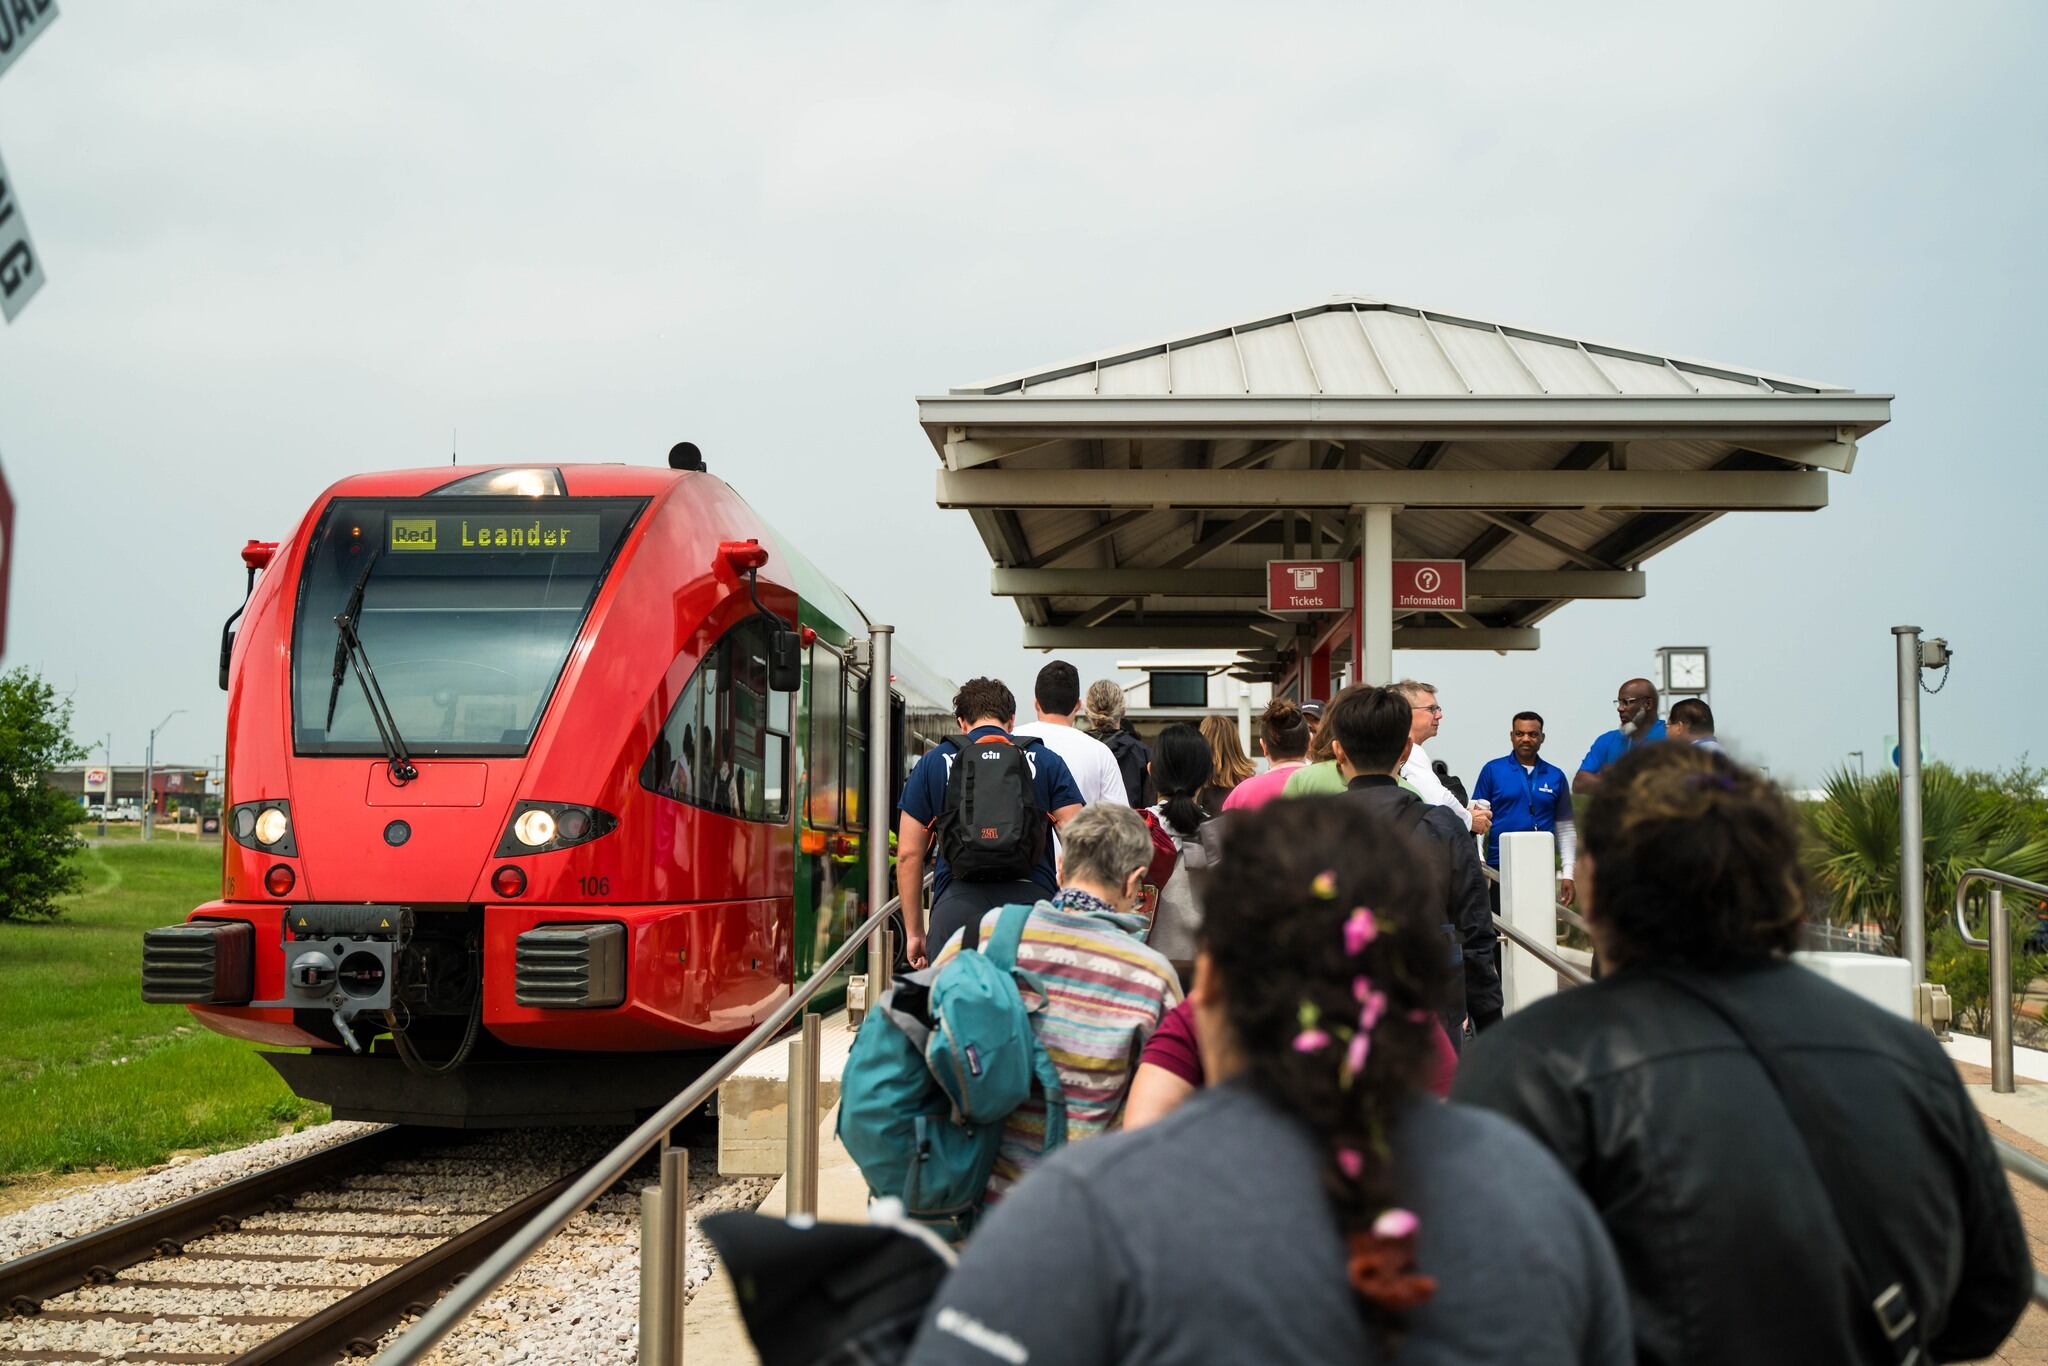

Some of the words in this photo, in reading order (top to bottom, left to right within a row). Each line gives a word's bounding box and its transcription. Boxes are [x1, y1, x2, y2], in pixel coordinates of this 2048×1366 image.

[394, 526, 433, 543] Red
[1290, 596, 1323, 606] Tickets
[1399, 594, 1456, 606] Information
[981, 750, 1001, 760] Gill
[578, 875, 609, 897] 106
